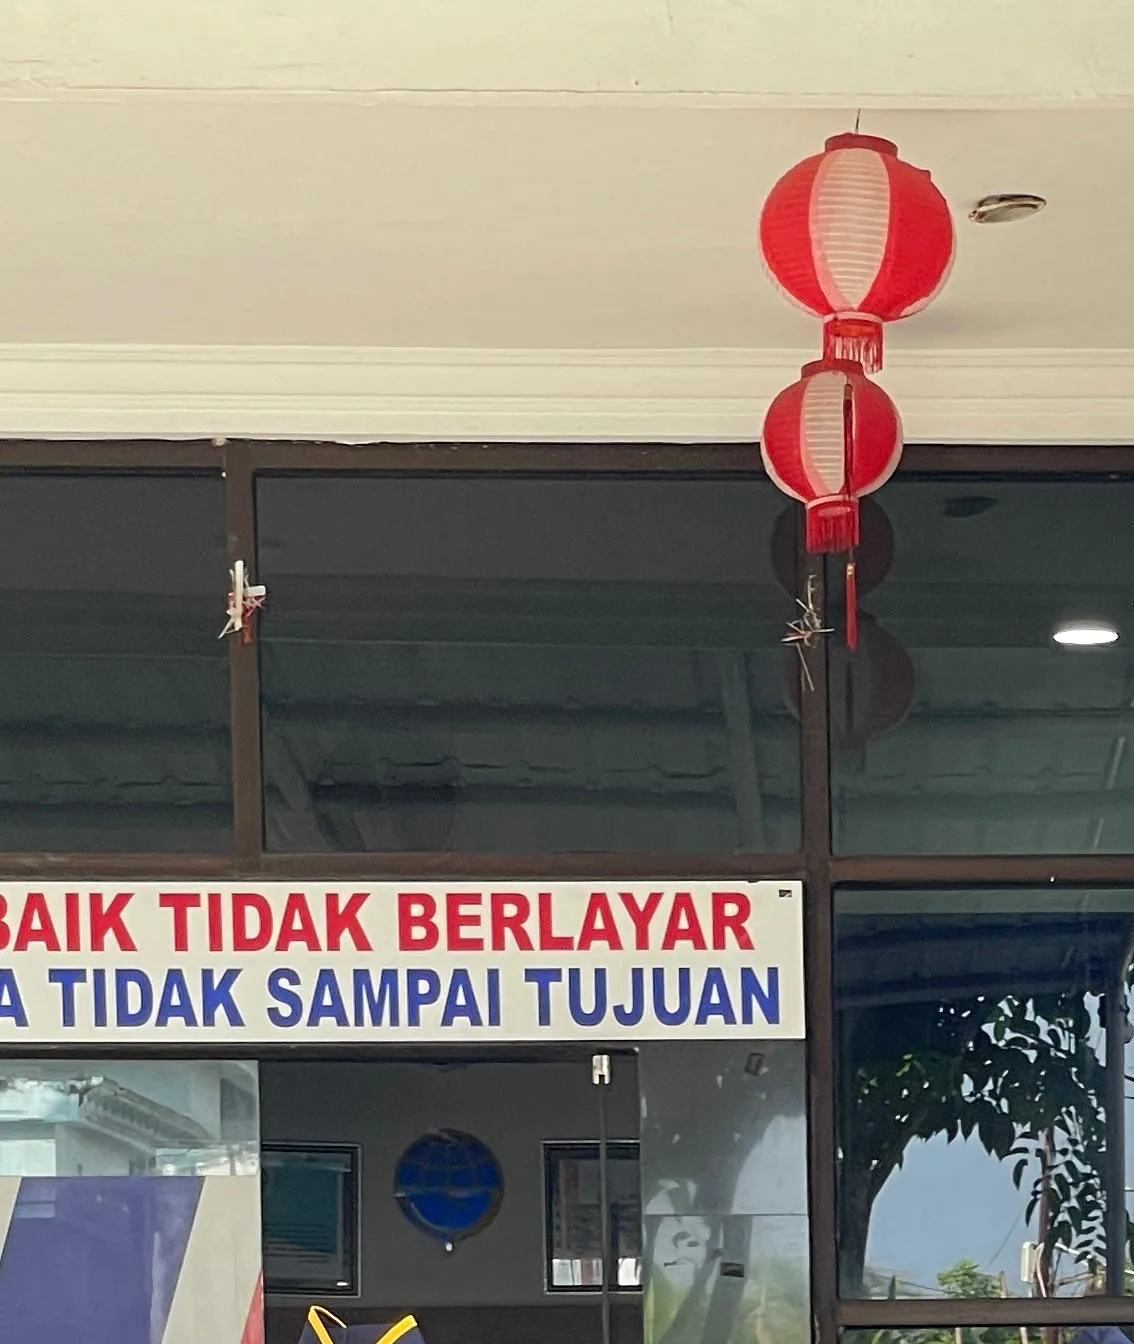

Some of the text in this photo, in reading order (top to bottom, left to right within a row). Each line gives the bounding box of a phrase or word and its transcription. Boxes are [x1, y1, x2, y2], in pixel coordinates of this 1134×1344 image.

[158, 892, 373, 952] TIDAK
[396, 892, 754, 951] BERLAYAR
[47, 968, 244, 1027] TIDAK
[266, 968, 501, 1027] SAMPAI
[524, 968, 780, 1026] TUJUAN
